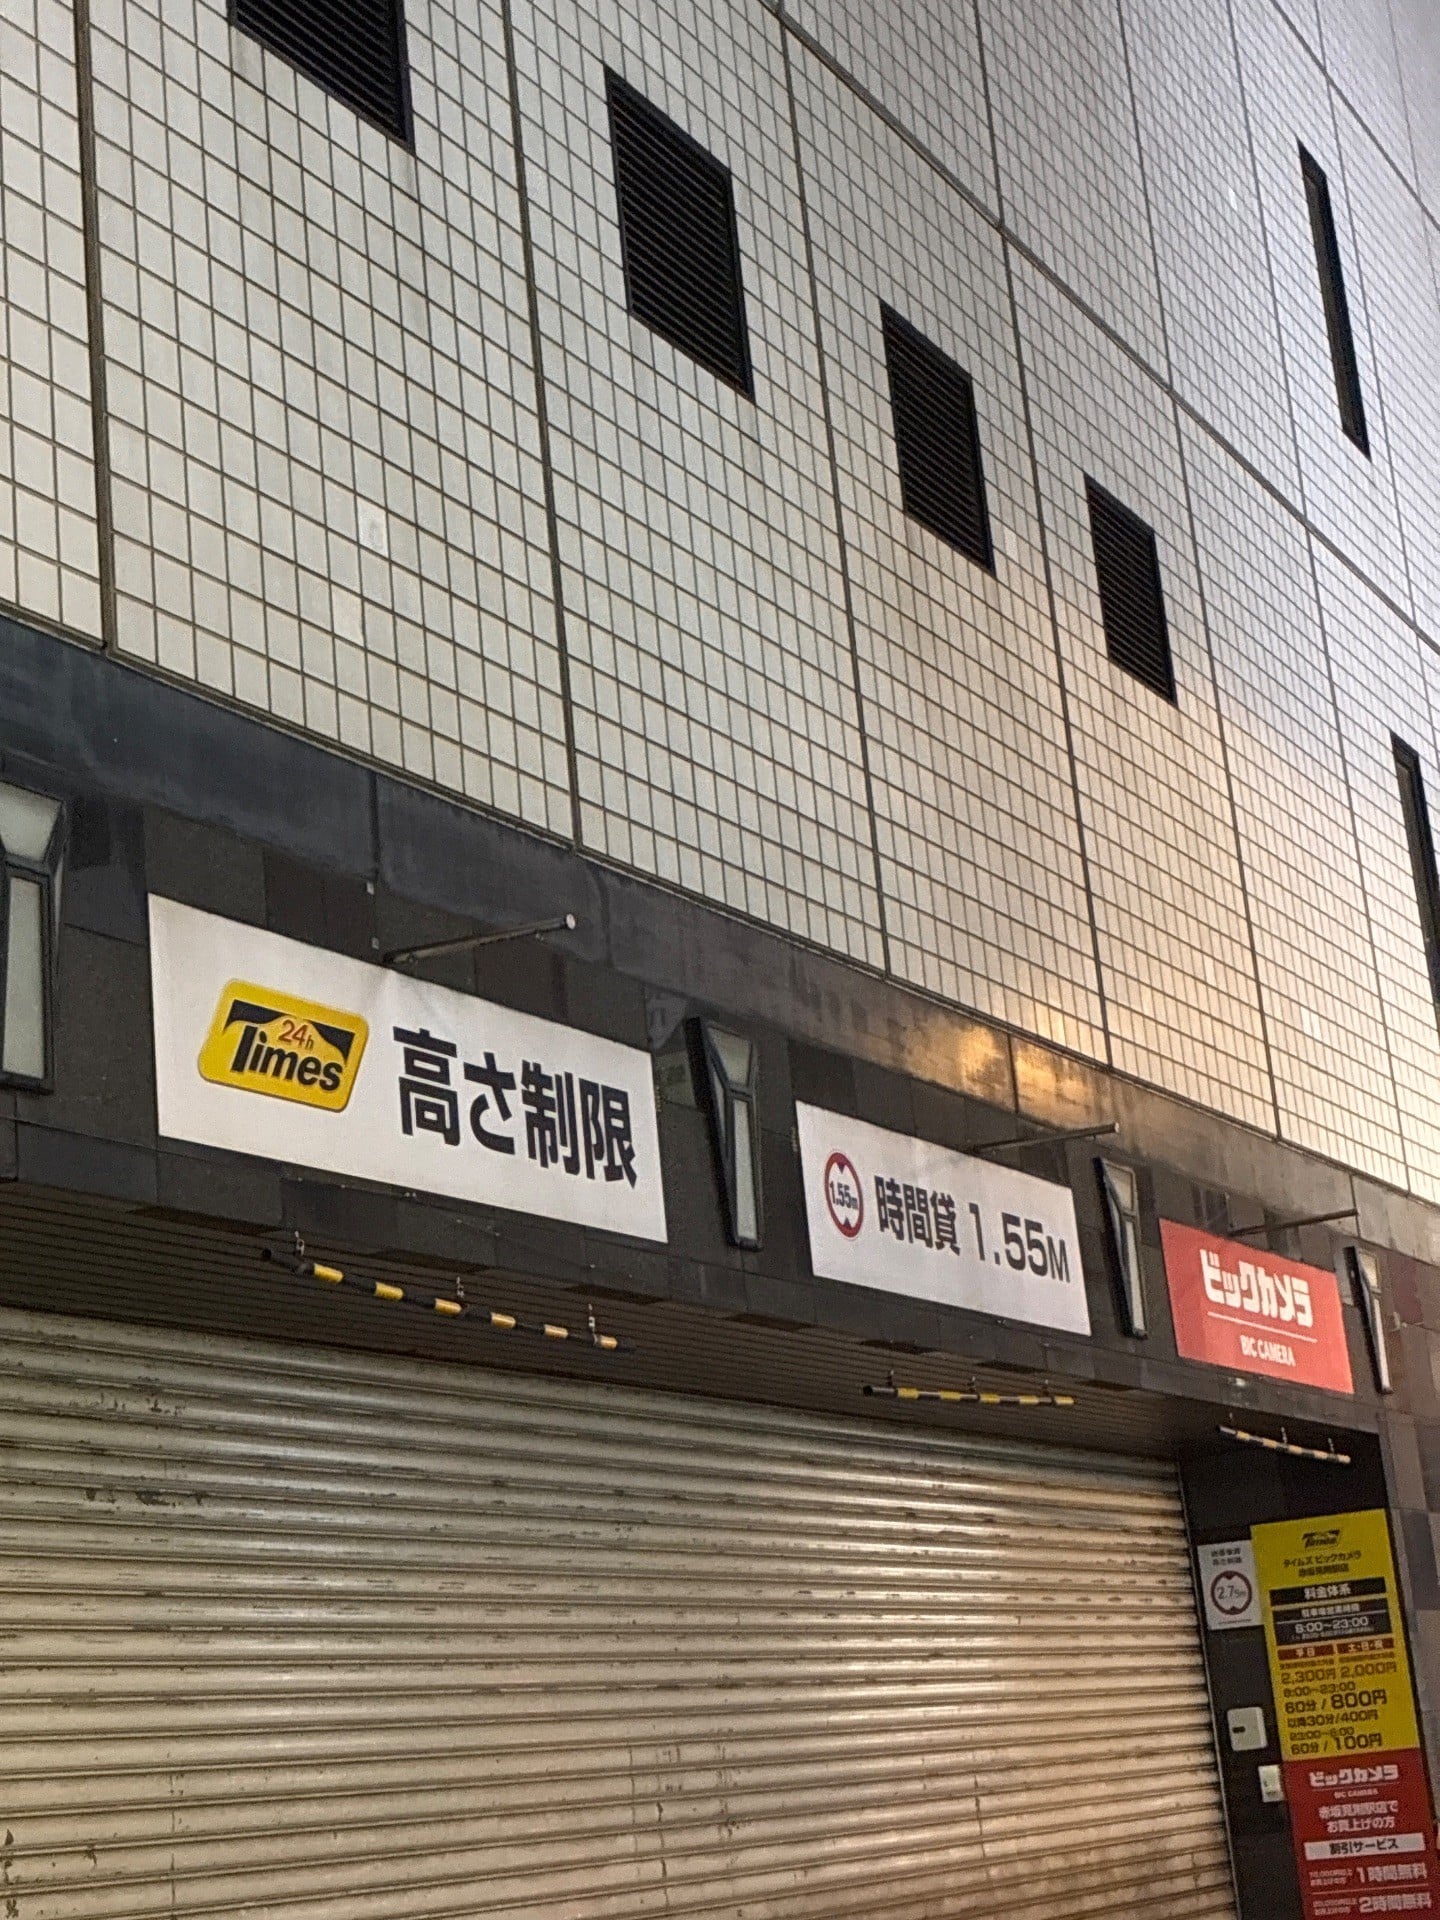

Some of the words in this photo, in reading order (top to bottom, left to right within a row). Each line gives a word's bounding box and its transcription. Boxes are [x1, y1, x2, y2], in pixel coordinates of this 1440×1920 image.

[278, 1018, 314, 1048] 24h
[227, 1012, 346, 1091] Times
[393, 1028, 637, 1189] 高さ制限
[829, 1181, 859, 1210] 1.55m
[874, 1175, 960, 1256] 時間貸
[969, 1202, 1070, 1283] 1.55M
[1200, 1249, 1313, 1328] ビックカメラ
[1240, 1334, 1258, 1358] BIC
[1257, 1340, 1296, 1367] CAMERA
[1304, 1583, 1351, 1600] 料金体系
[1330, 1688, 1388, 1710] 800円
[1335, 1733, 1383, 1751] 100円
[1309, 1764, 1399, 1787] ビックカメラ
[1329, 1838, 1399, 1855] 割引サービス
